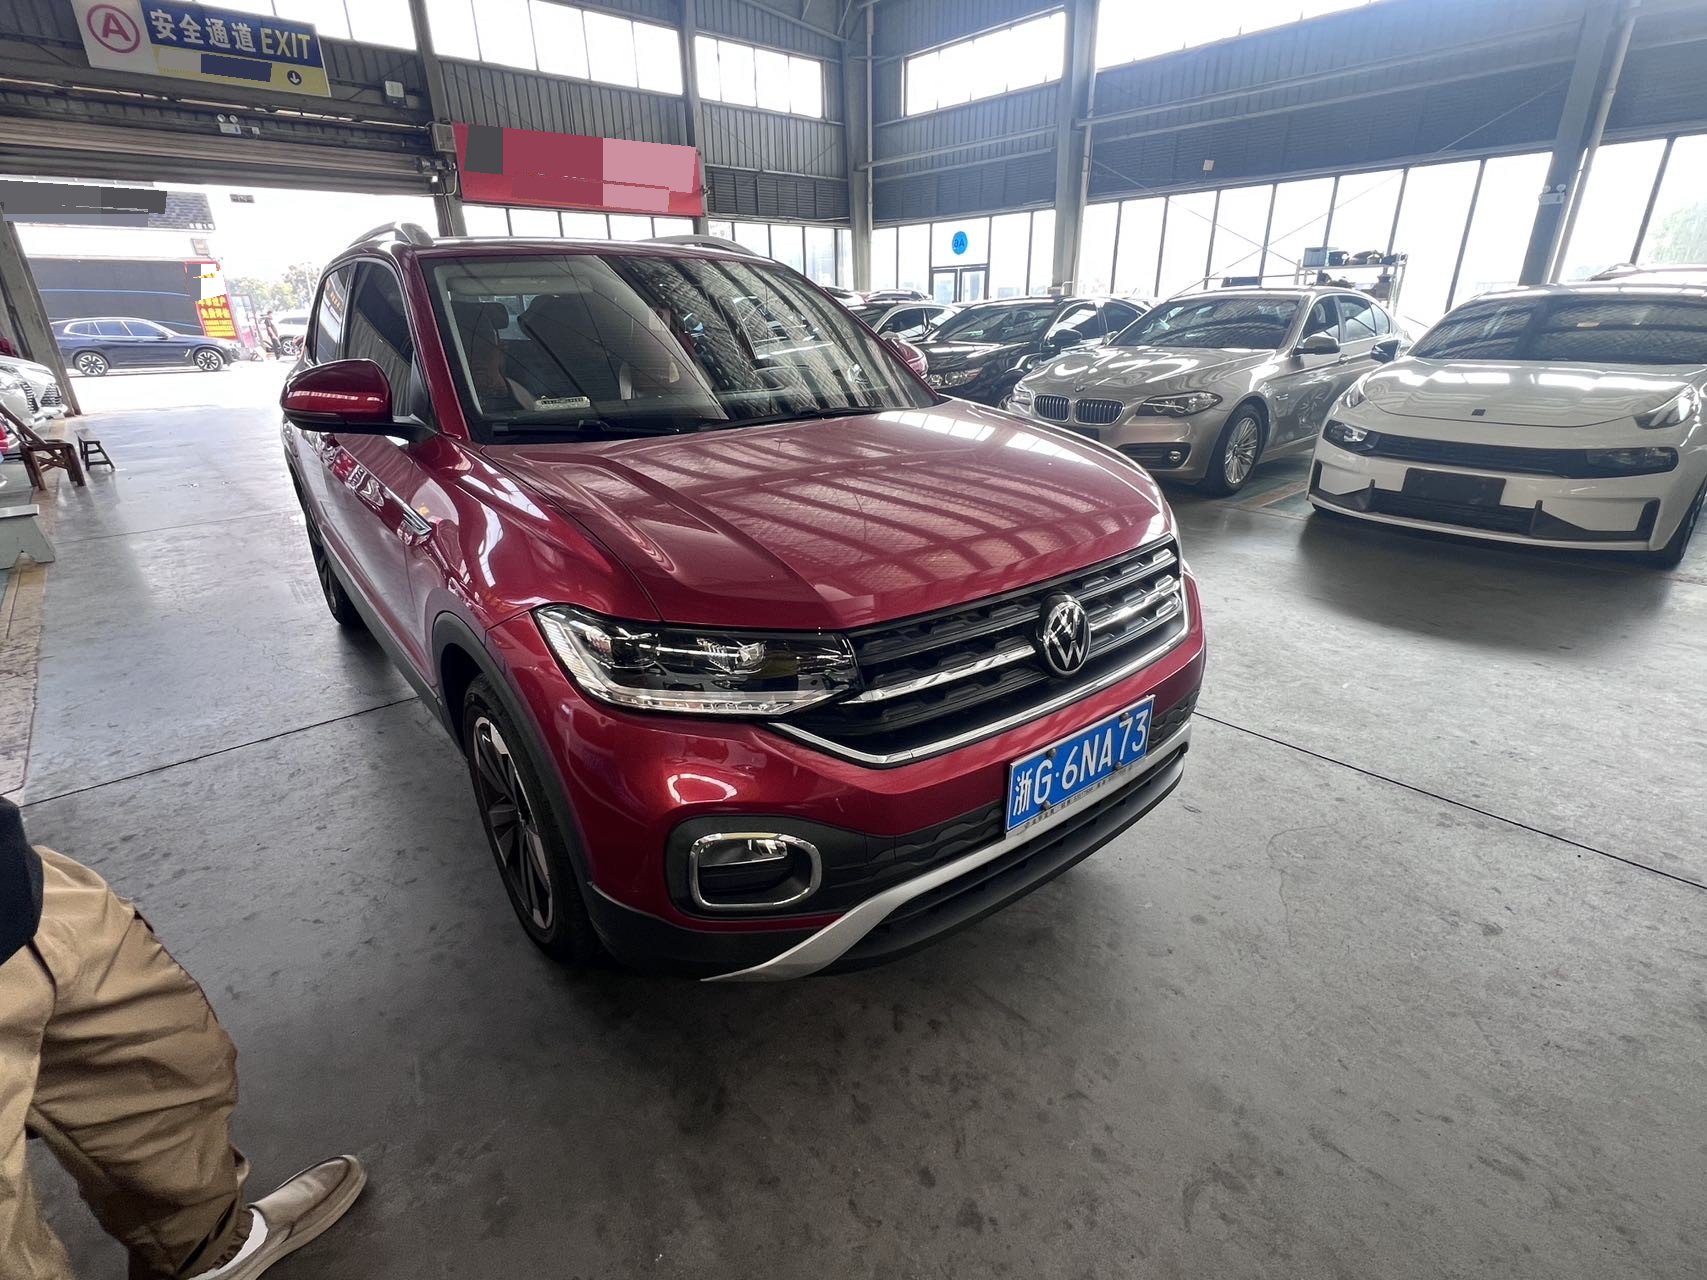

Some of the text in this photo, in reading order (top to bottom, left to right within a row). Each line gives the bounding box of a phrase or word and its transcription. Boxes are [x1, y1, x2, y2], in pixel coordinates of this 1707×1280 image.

[102, 12, 132, 42] A
[150, 9, 311, 60] 安全通道 EXIT
